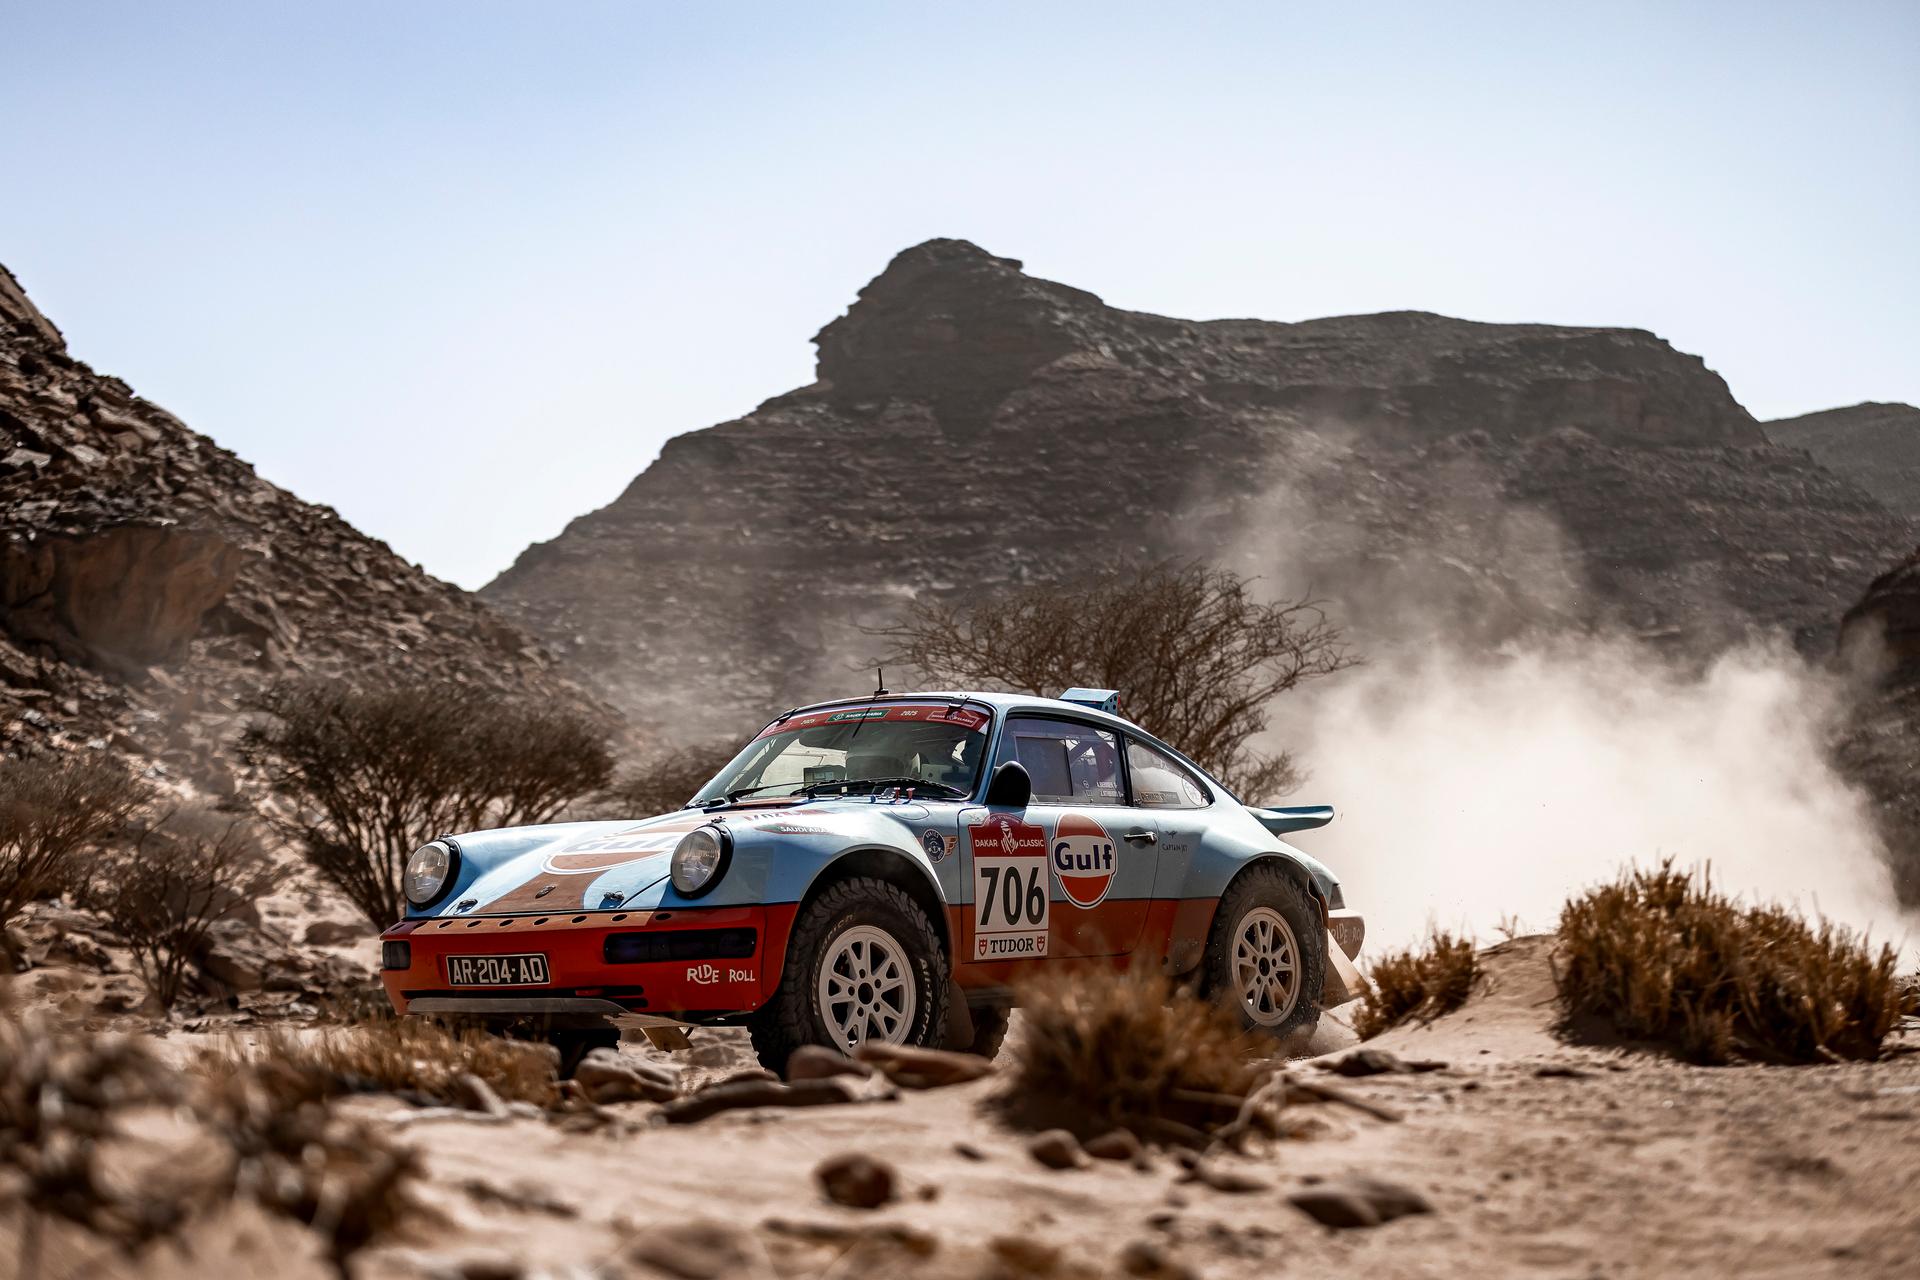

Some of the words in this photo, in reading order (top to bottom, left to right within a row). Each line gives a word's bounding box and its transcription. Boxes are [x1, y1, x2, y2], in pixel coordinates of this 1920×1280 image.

[780, 826, 808, 834] SAUDI
[975, 839, 999, 848] DAKAR
[1019, 839, 1045, 848] CLASSIC
[1054, 842, 1113, 871] Gulf
[980, 866, 1046, 926] 706
[990, 938, 1034, 953] TUDOR
[686, 964, 720, 985] RIDE
[729, 969, 756, 983] ROLL
